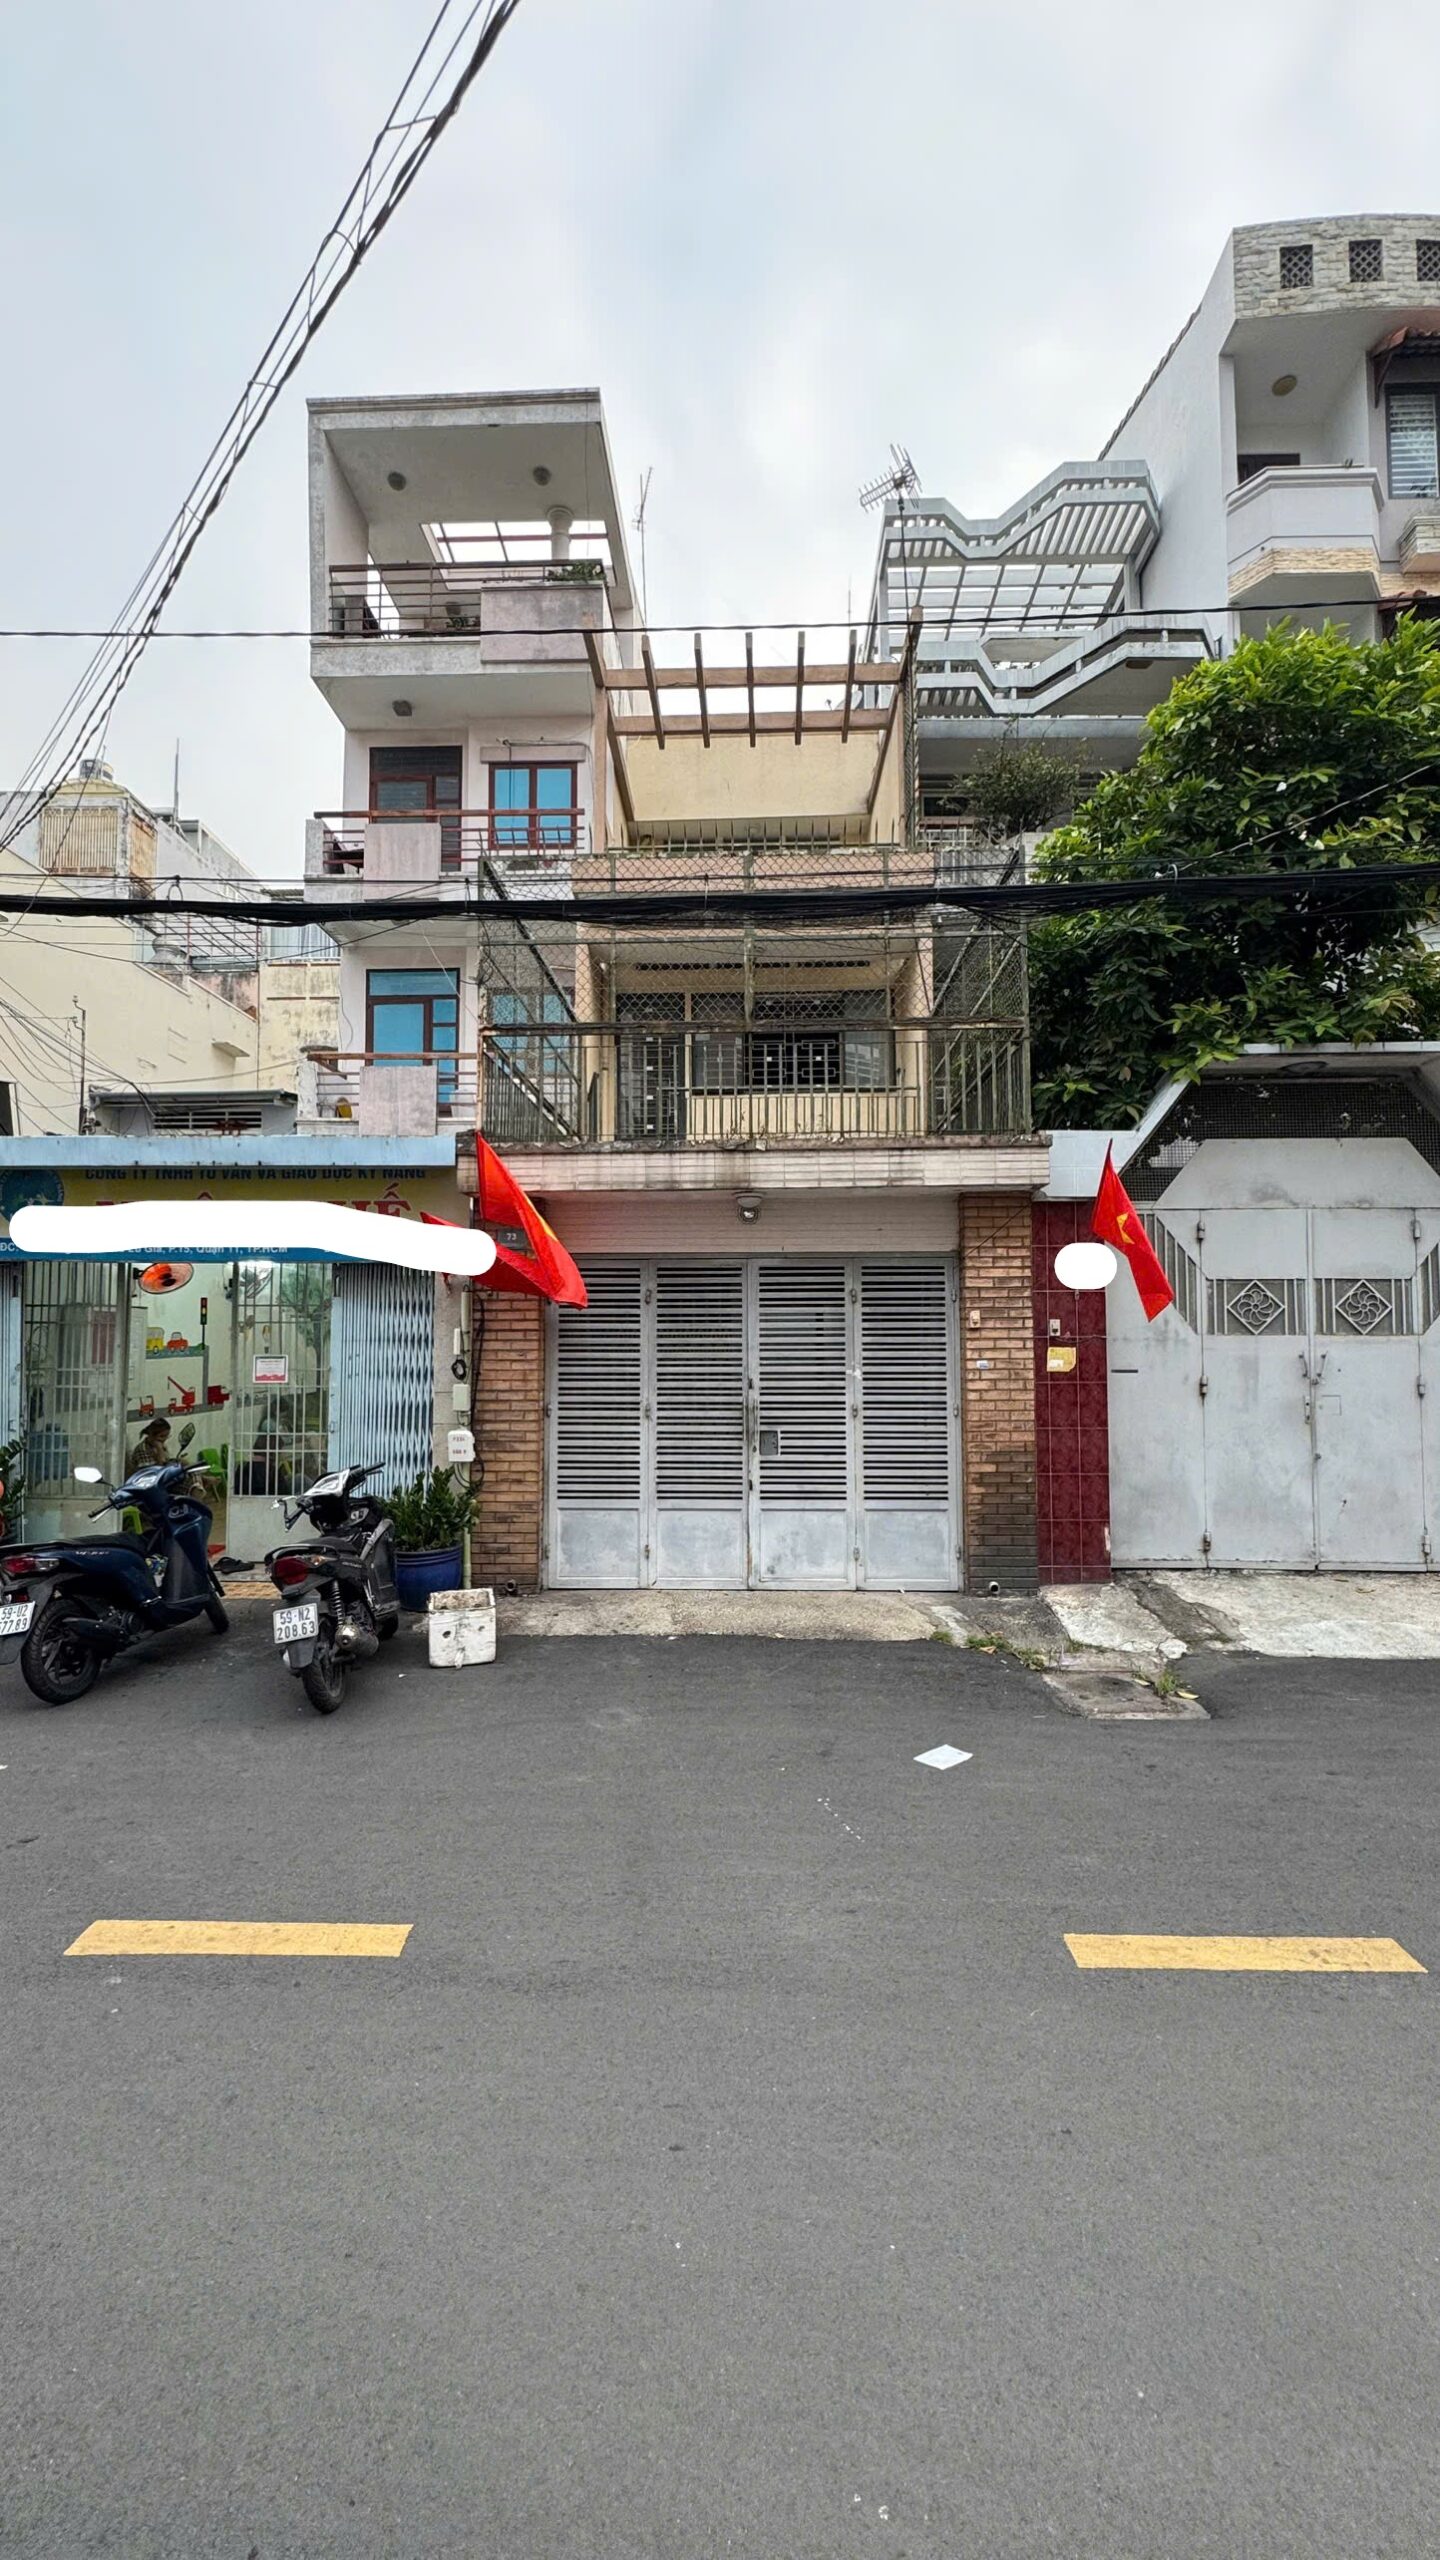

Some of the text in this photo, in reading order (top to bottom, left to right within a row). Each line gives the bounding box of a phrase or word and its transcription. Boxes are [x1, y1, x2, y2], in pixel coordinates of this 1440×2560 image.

[506, 1232, 517, 1240] 73
[0, 1618, 27, 1634] 77.89
[276, 1621, 315, 1640] 208.63
